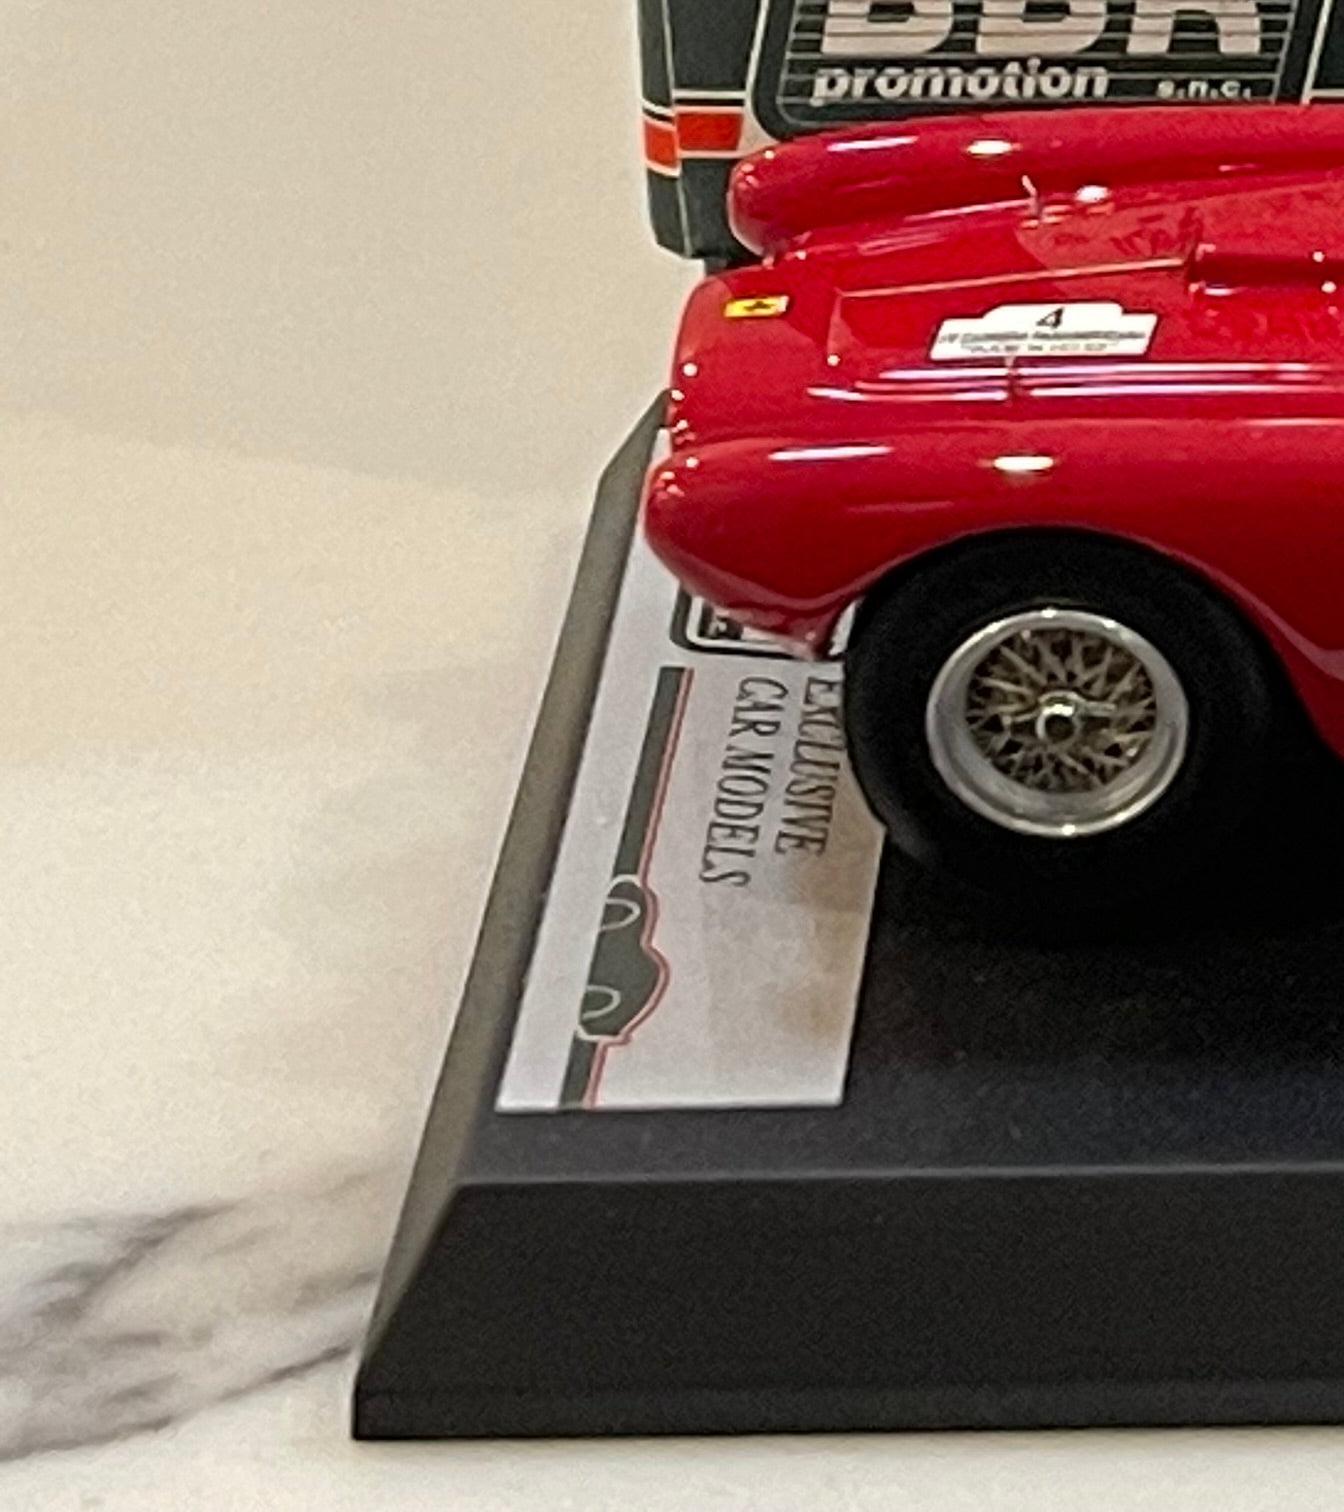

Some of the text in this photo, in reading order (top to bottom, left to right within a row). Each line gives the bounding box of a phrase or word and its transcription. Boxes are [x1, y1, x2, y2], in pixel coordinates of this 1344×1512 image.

[809, 57, 1109, 105] promotion
[1036, 306, 1065, 329] 4
[699, 675, 789, 888] CAR MODELS
[775, 675, 845, 857] EXCLUSIVE
